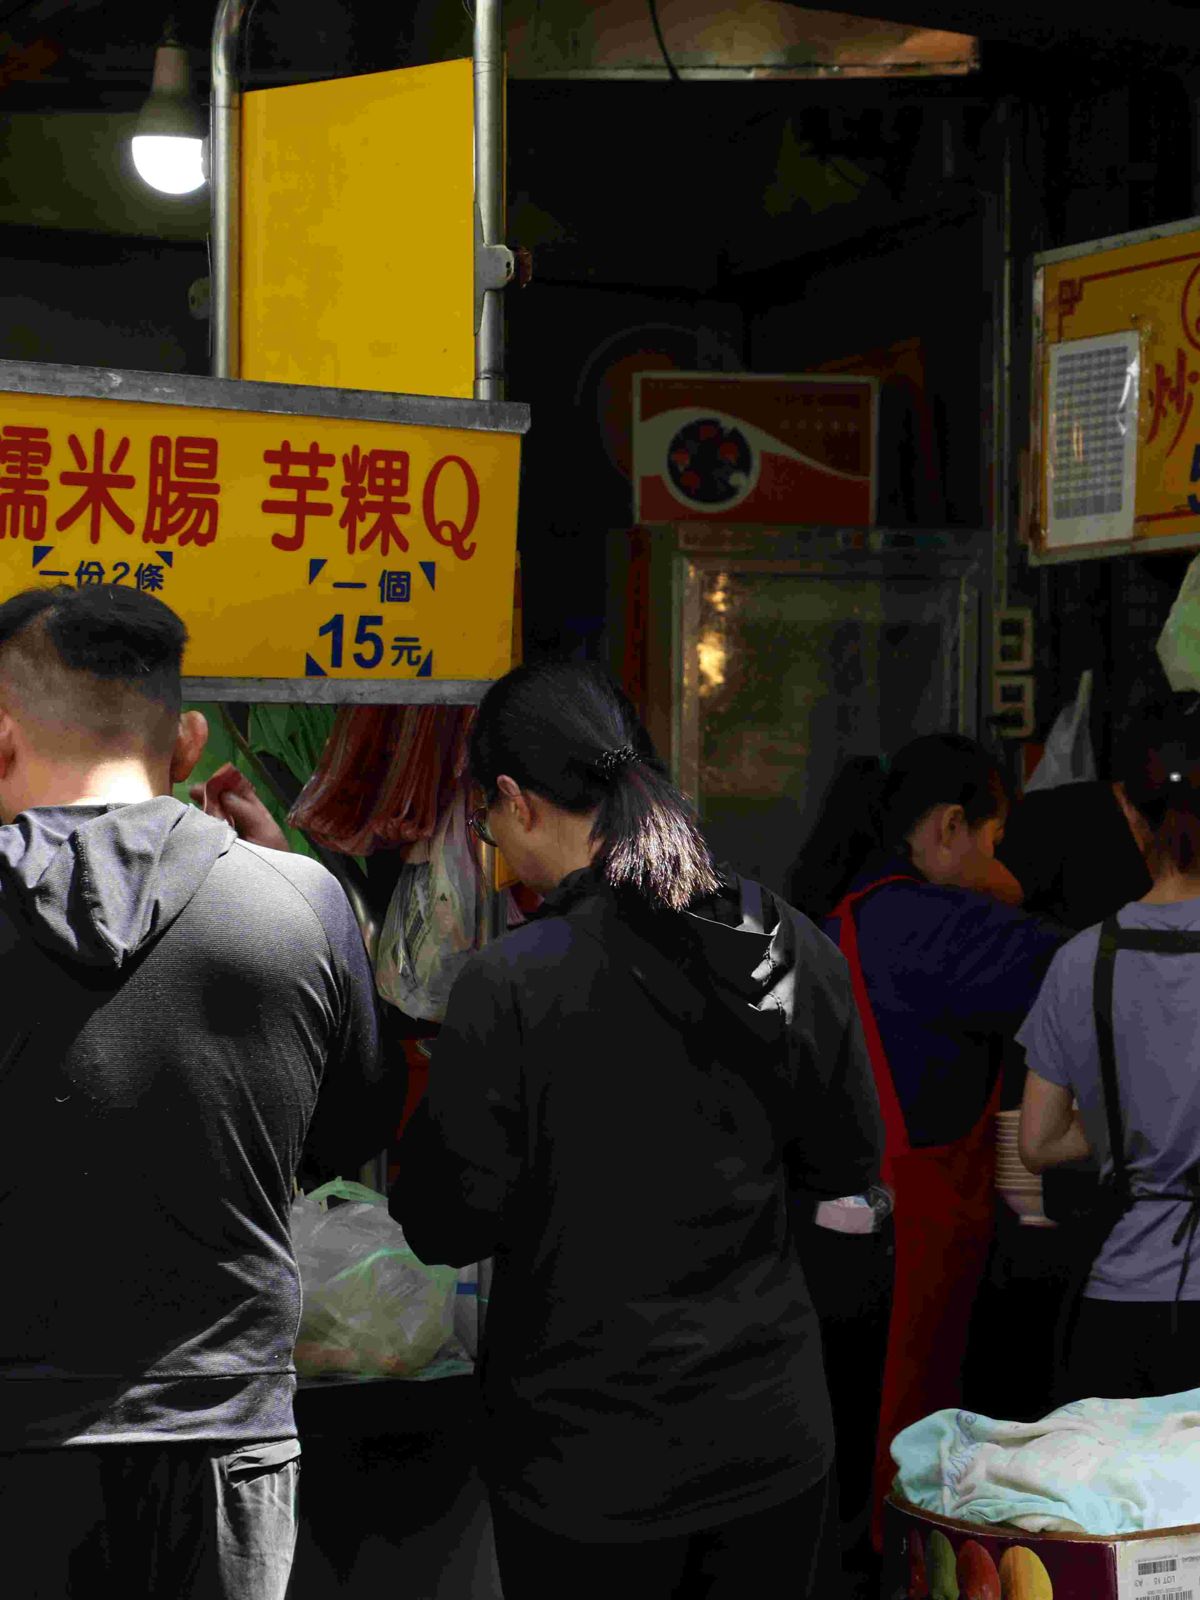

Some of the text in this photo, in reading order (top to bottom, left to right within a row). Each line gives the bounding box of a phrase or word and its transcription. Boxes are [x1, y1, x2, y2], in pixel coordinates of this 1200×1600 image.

[261, 439, 480, 560] 芋粿Q
[332, 569, 412, 603] 一個
[318, 613, 422, 669] 15元
